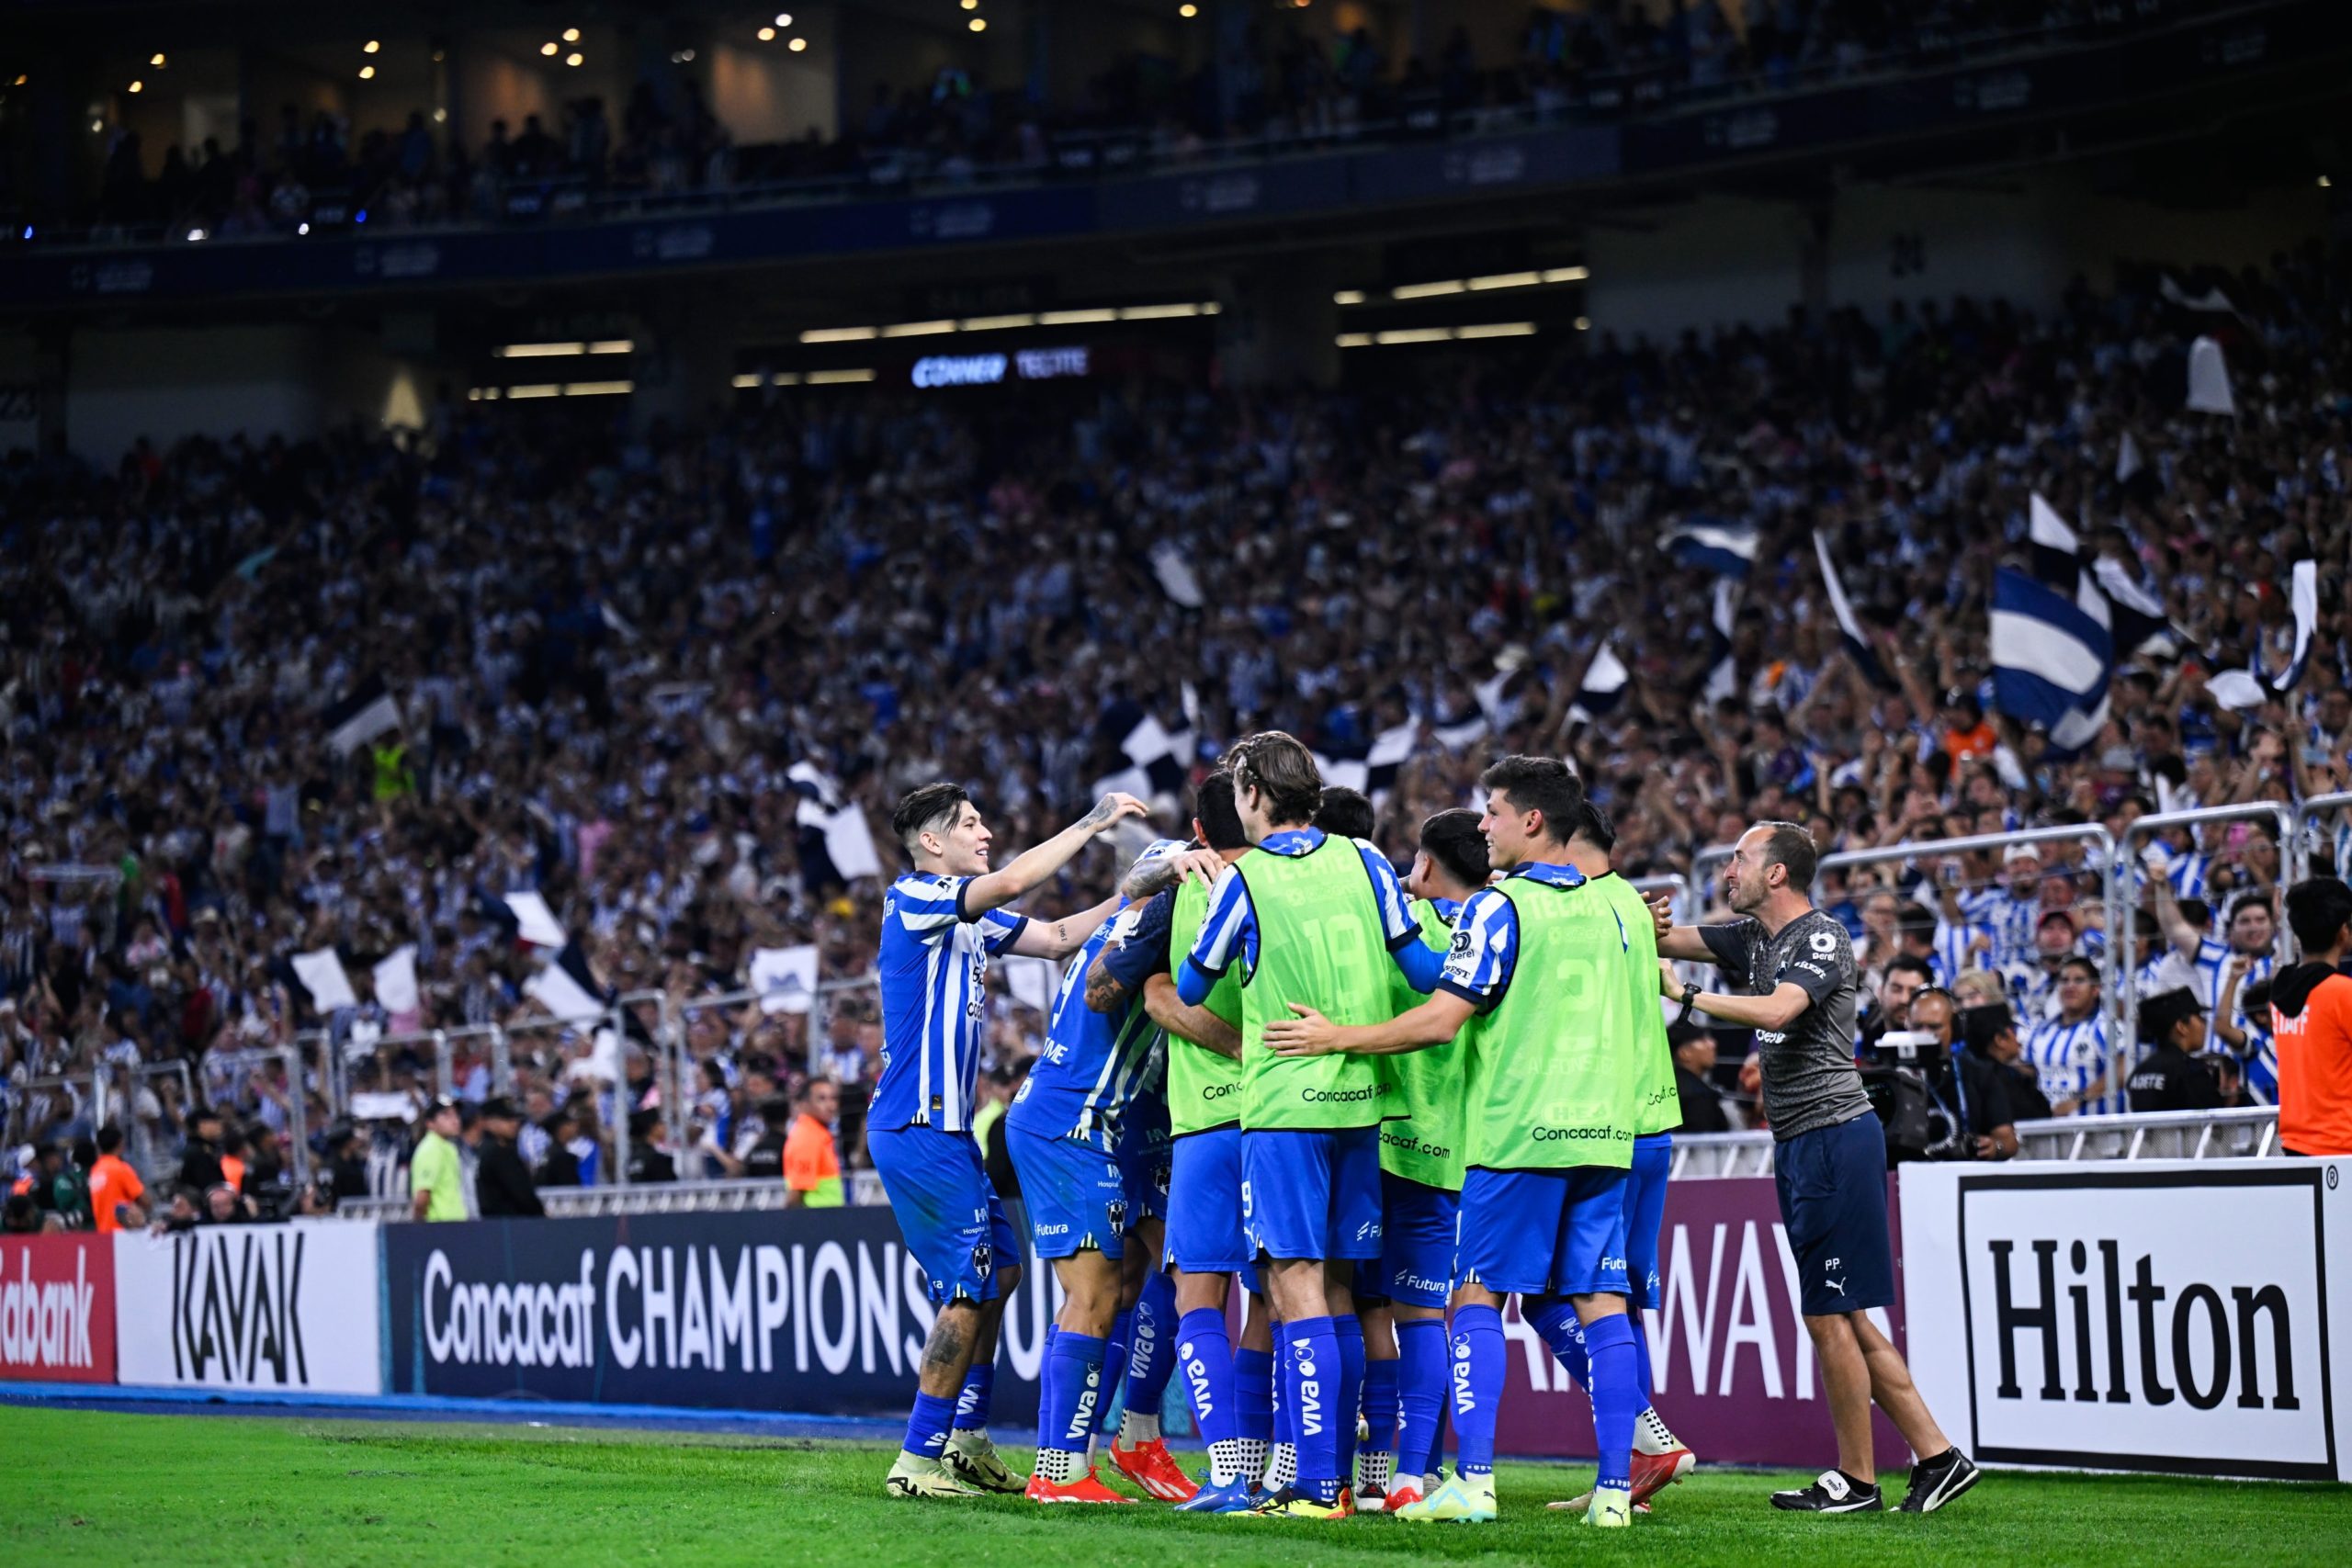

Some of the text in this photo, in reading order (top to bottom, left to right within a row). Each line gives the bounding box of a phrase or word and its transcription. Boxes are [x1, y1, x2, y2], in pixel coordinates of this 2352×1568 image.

[1451, 949, 1475, 962] Berel
[1037, 1224, 1069, 1236] Futura
[1407, 1274, 1446, 1292] Futura
[0, 1245, 95, 1368] abank
[174, 1232, 310, 1385] KAVAK
[424, 1247, 595, 1368] Concacaf
[1987, 1238, 2301, 1411] Hilton
